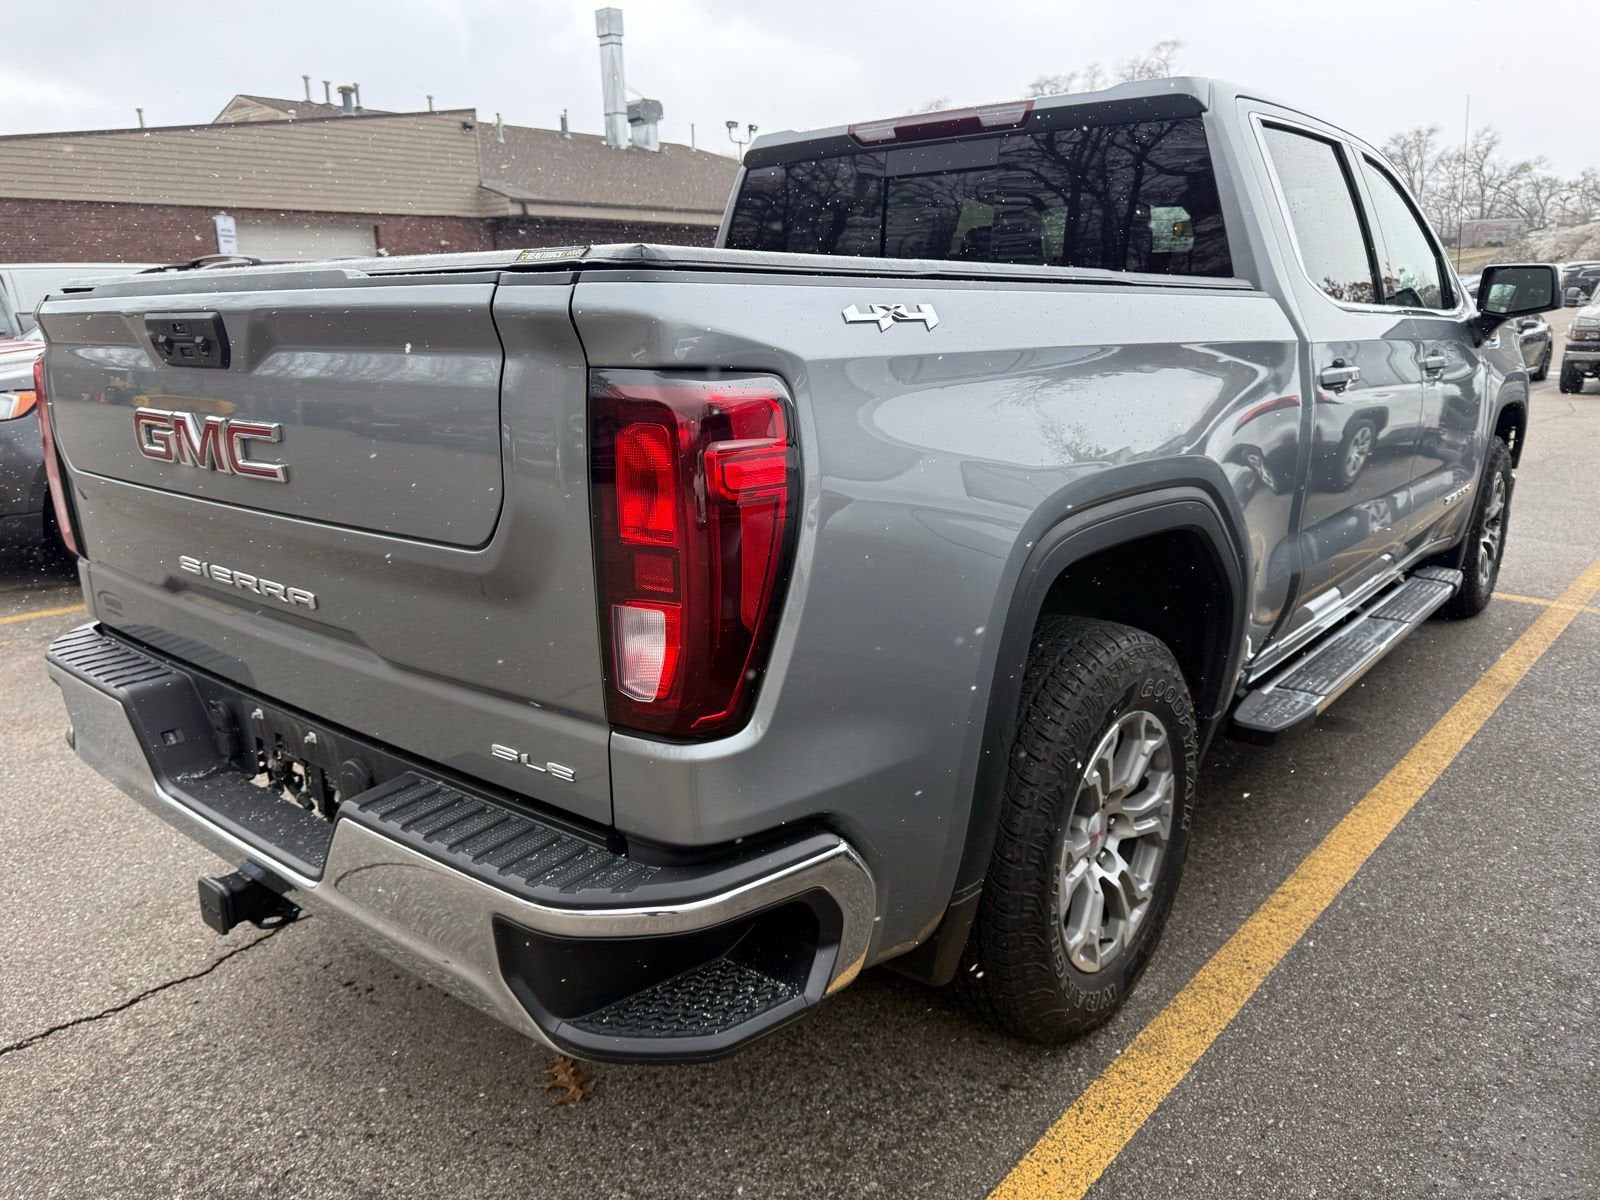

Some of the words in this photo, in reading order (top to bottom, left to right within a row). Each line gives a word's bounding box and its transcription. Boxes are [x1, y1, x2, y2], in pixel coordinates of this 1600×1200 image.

[134, 407, 288, 483] GMC
[179, 555, 317, 610] SIERRA
[491, 743, 575, 782] SLE
[1140, 677, 1198, 833] GOODYEAR
